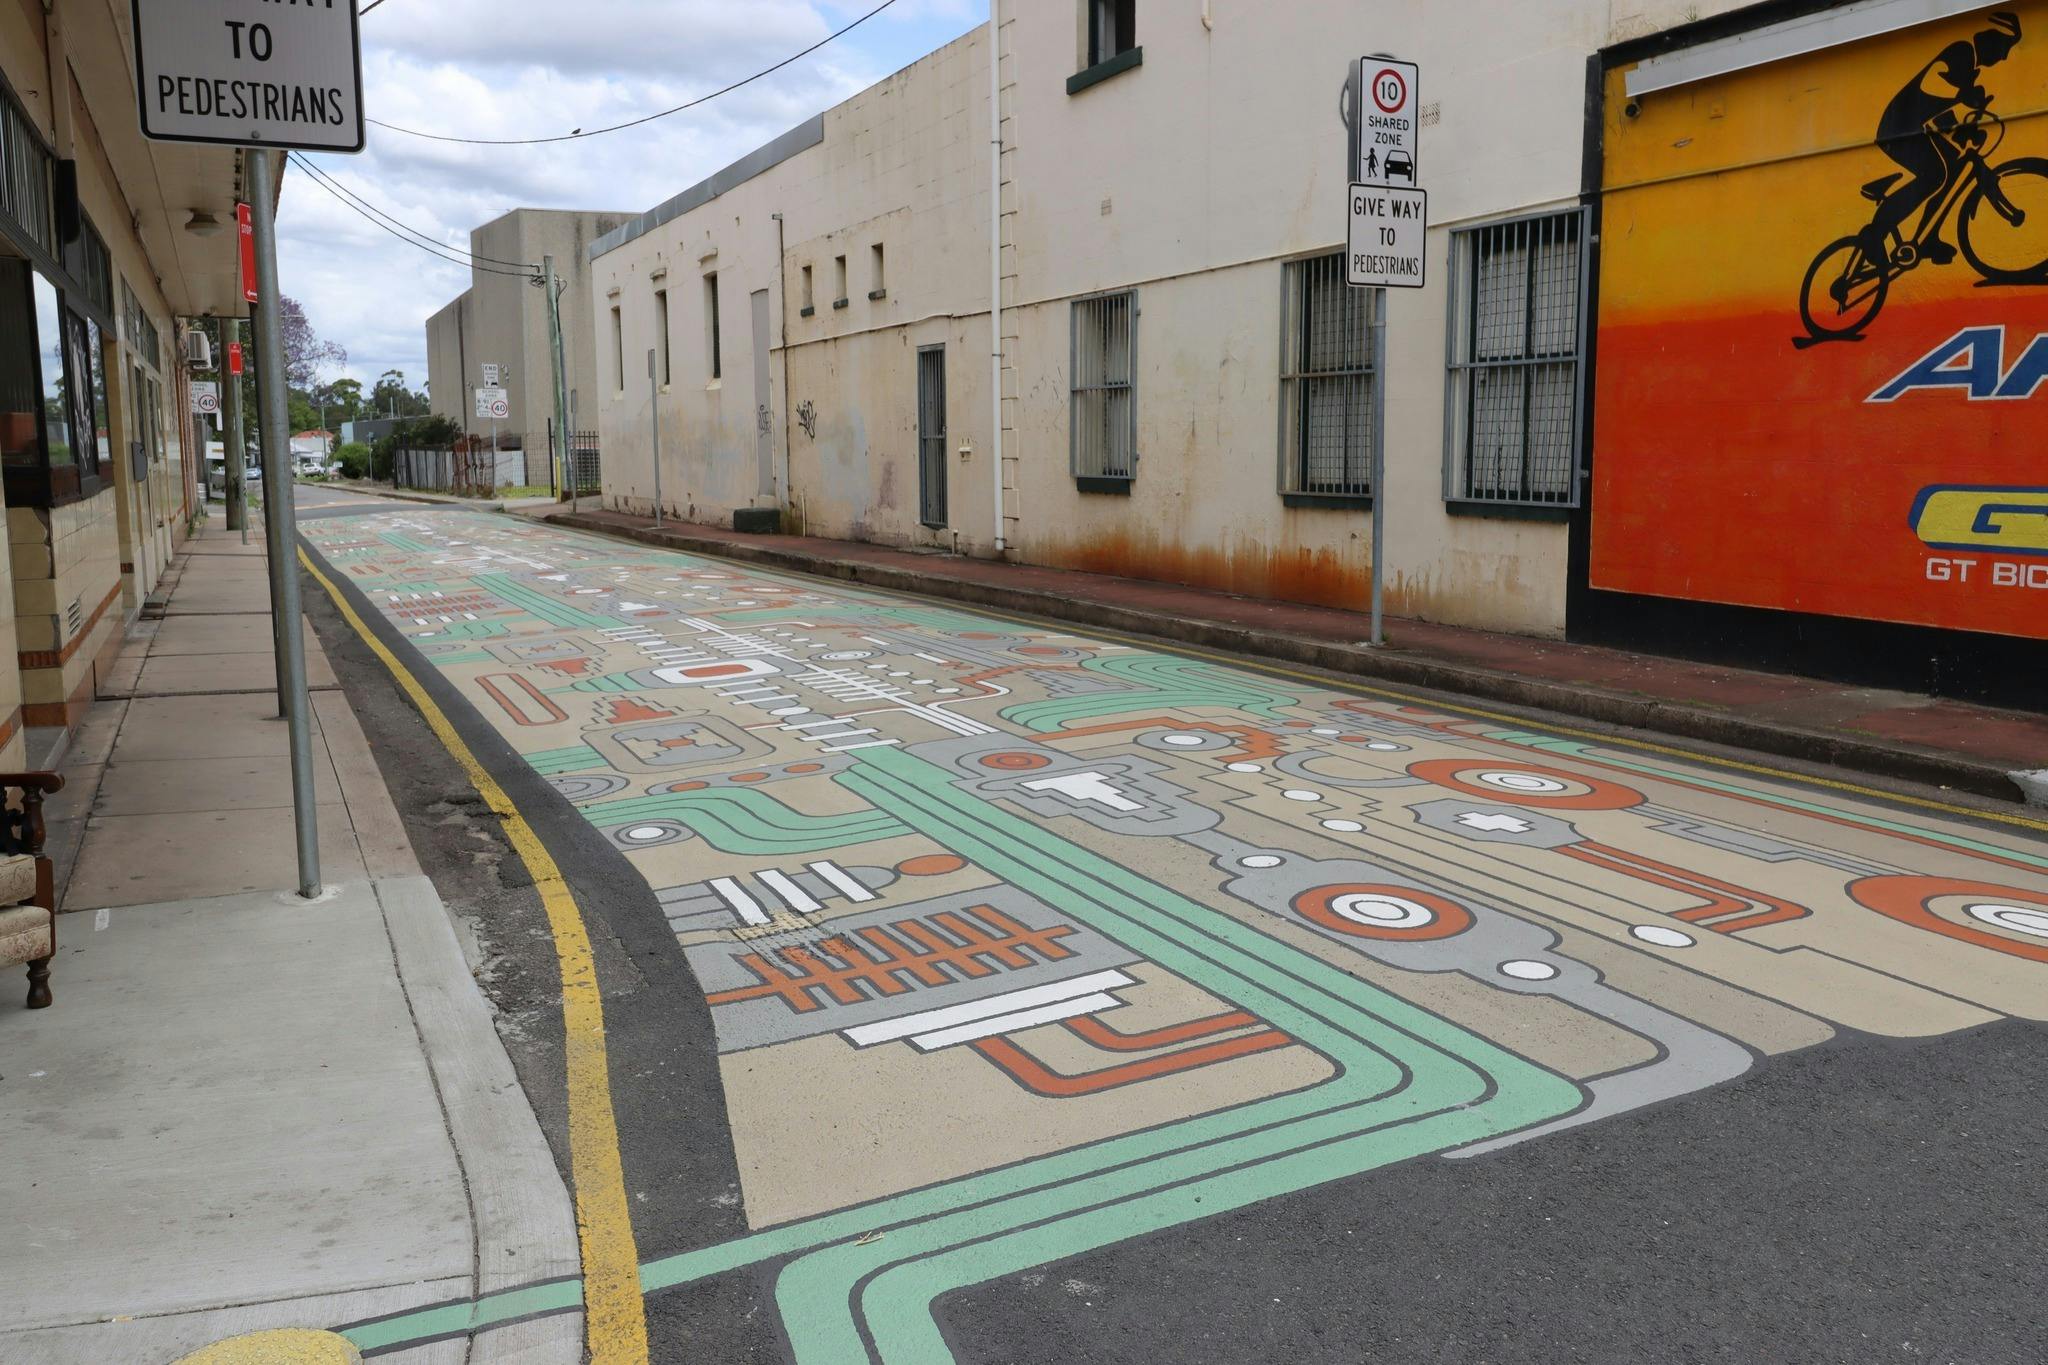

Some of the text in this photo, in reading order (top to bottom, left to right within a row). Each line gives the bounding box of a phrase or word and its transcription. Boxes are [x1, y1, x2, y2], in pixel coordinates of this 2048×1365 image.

[225, 21, 272, 61] TO
[158, 75, 344, 125] PEDESTRIANS
[1381, 81, 1398, 101] 10
[1368, 116, 1409, 131] SHARED
[1375, 132, 1402, 146] ZONE
[1354, 197, 1421, 220] GIVE WAY
[1379, 228, 1396, 246] TO
[1353, 254, 1419, 276] PEDESTRIANS
[202, 398, 215, 407] 40
[495, 404, 506, 412] 40
[1926, 558, 1977, 582] GT
